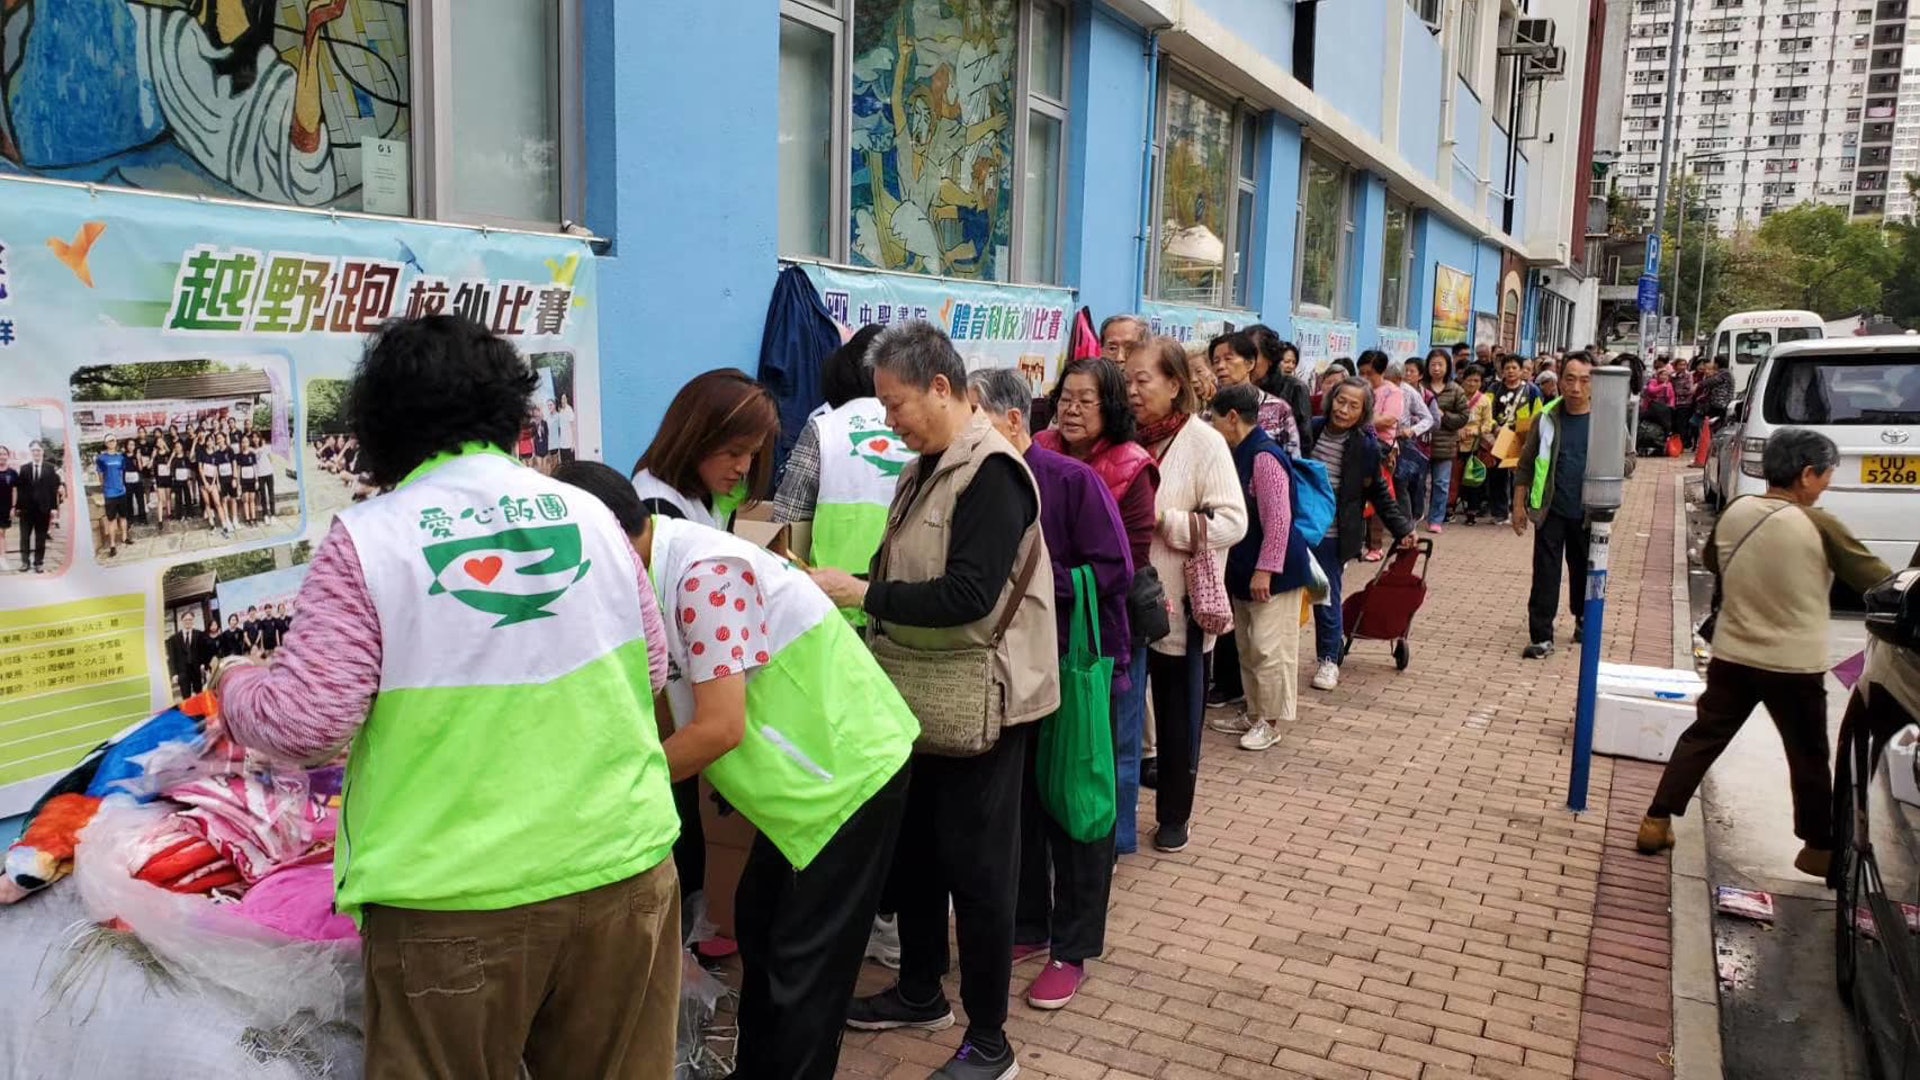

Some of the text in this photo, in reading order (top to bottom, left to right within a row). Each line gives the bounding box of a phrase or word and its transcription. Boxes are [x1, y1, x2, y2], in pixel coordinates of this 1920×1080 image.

[1648, 238, 1658, 271] P
[168, 249, 572, 335] 越野跑 校外比賽
[950, 302, 1063, 341] 體育科校外比賽
[1751, 315, 1791, 325] TOYOTA
[1866, 469, 1917, 484] 5268
[1880, 456, 1905, 471] UU
[419, 493, 568, 539] 愛心飯團
